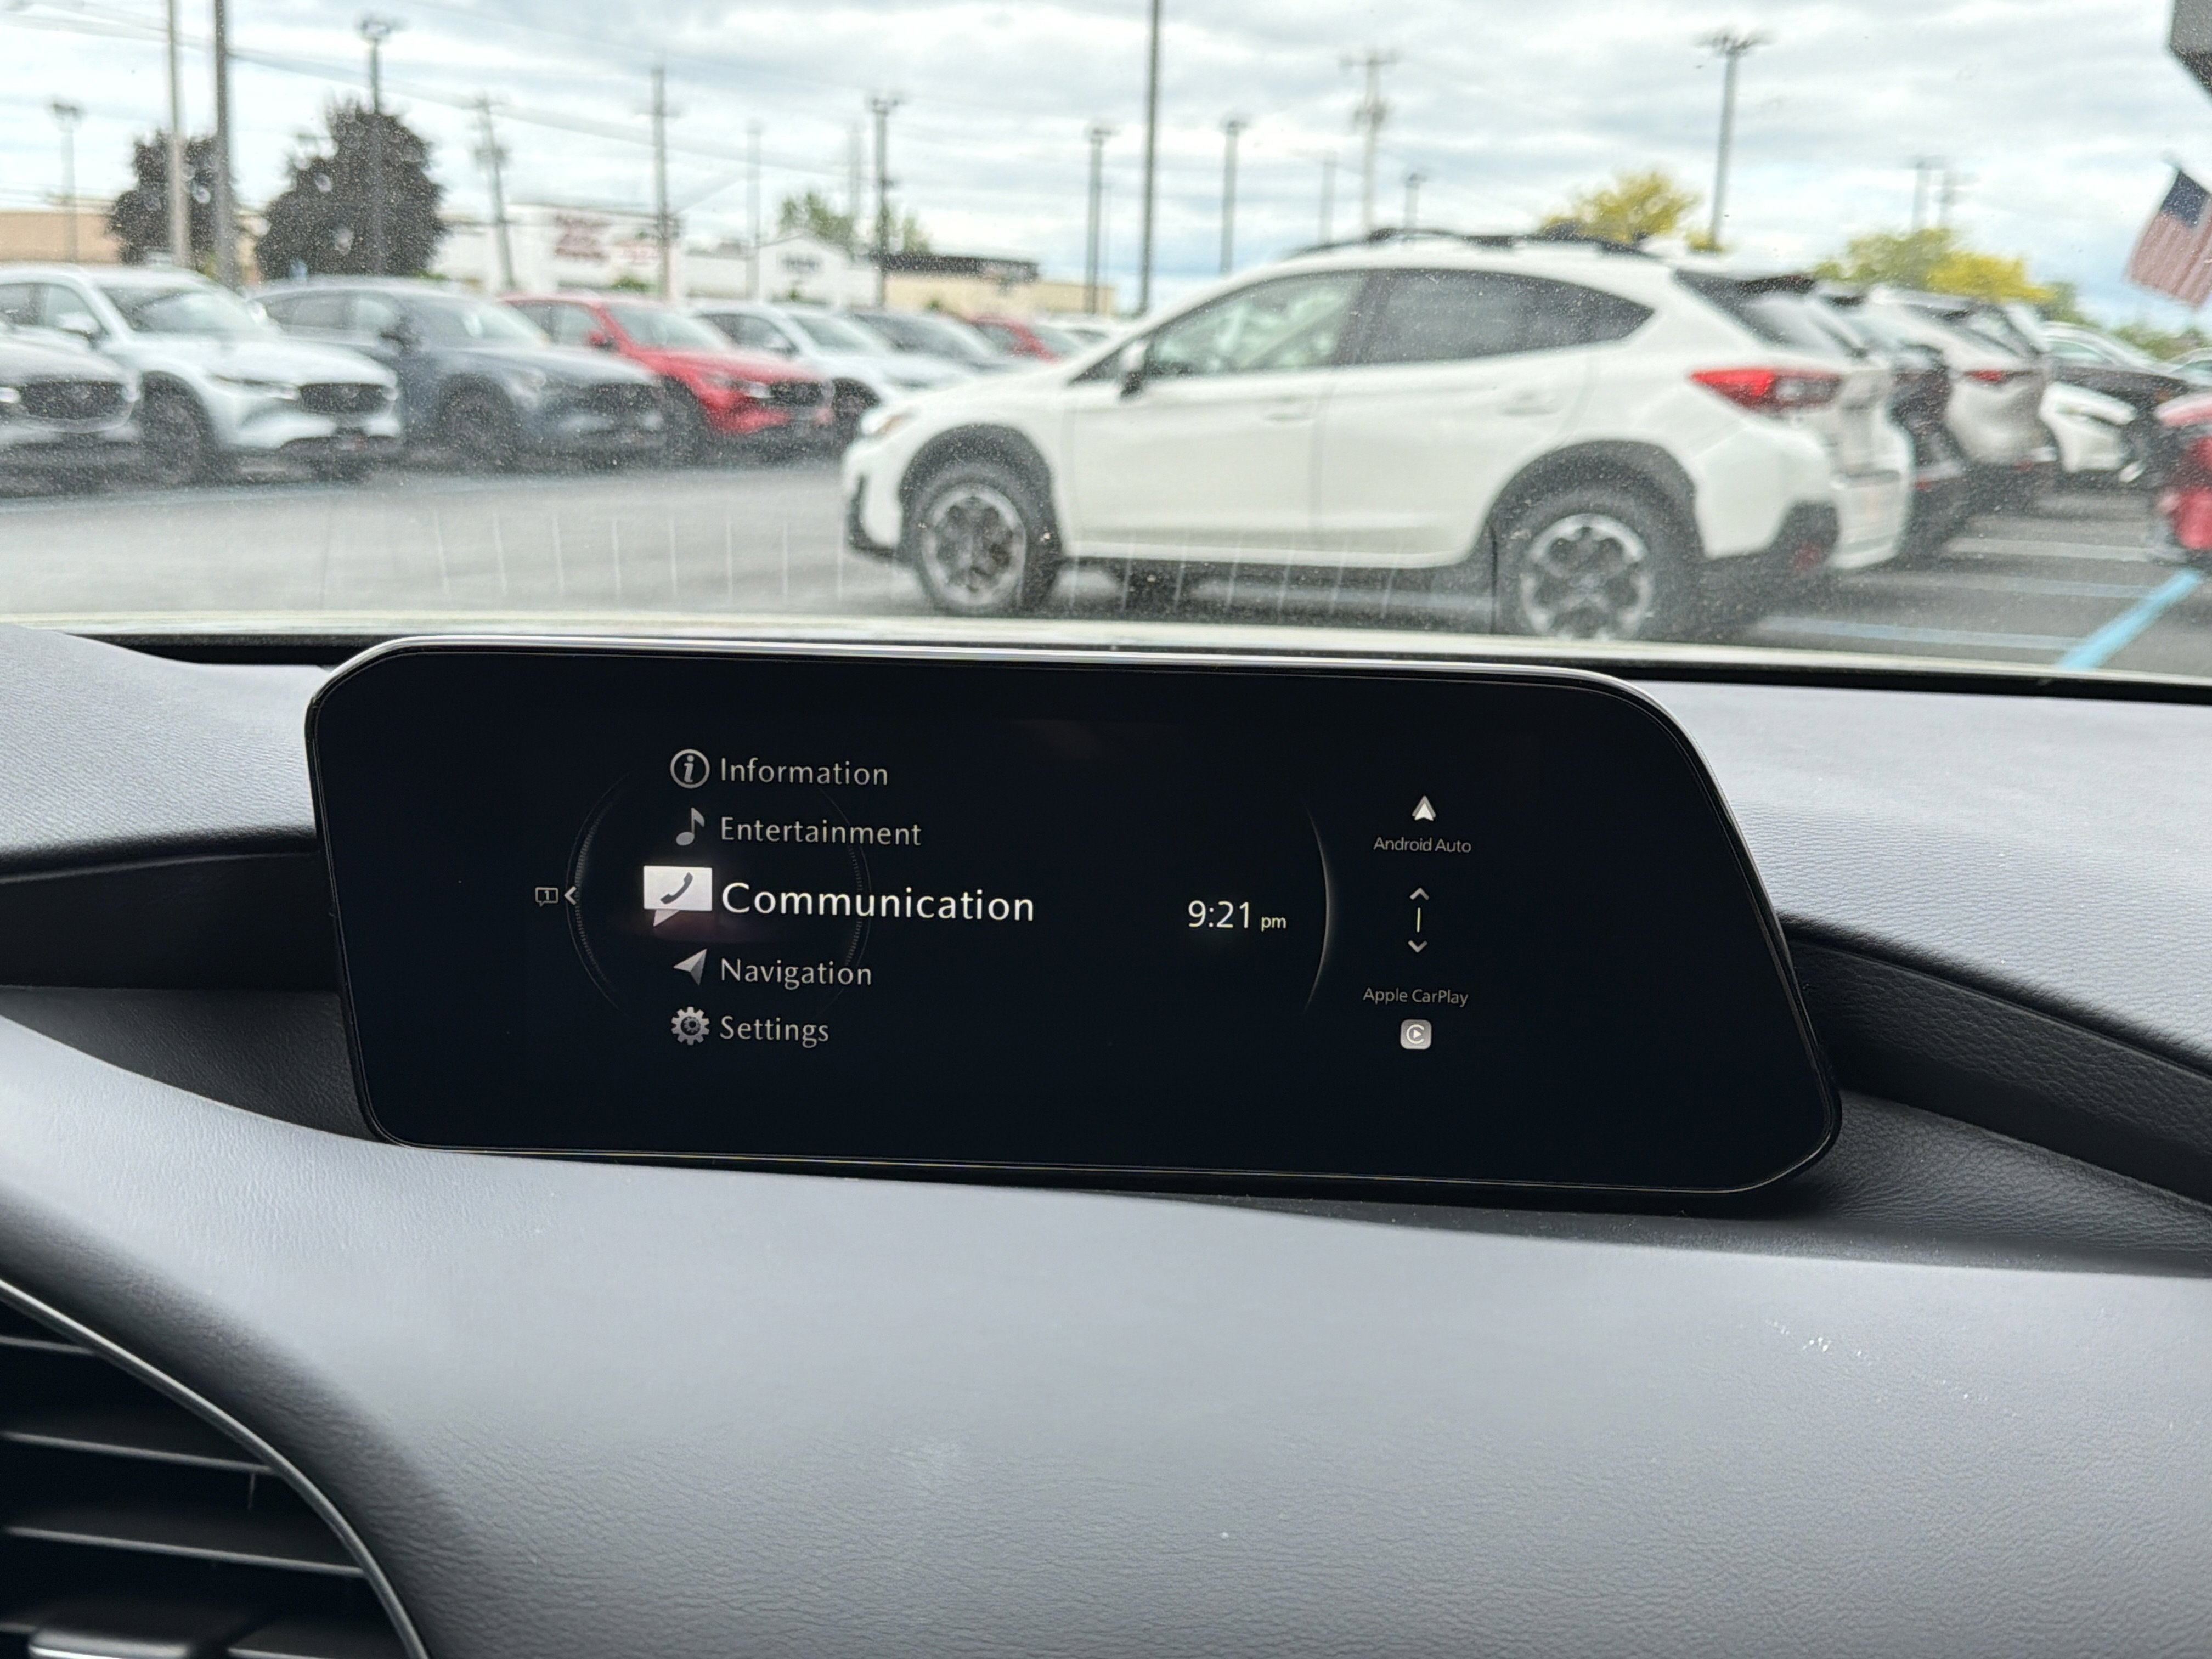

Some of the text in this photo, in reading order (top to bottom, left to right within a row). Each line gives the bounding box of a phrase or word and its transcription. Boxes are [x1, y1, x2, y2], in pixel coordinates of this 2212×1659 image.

[721, 757, 888, 785] Information
[721, 816, 921, 845] Entertainment
[1373, 837, 1472, 853] Android Auto
[721, 882, 1034, 922] Communication
[1188, 900, 1287, 933] 9:21 pm
[721, 958, 871, 990] Navigation
[1363, 988, 1469, 1008] Apple CarPlay
[720, 1015, 829, 1048] Settings
